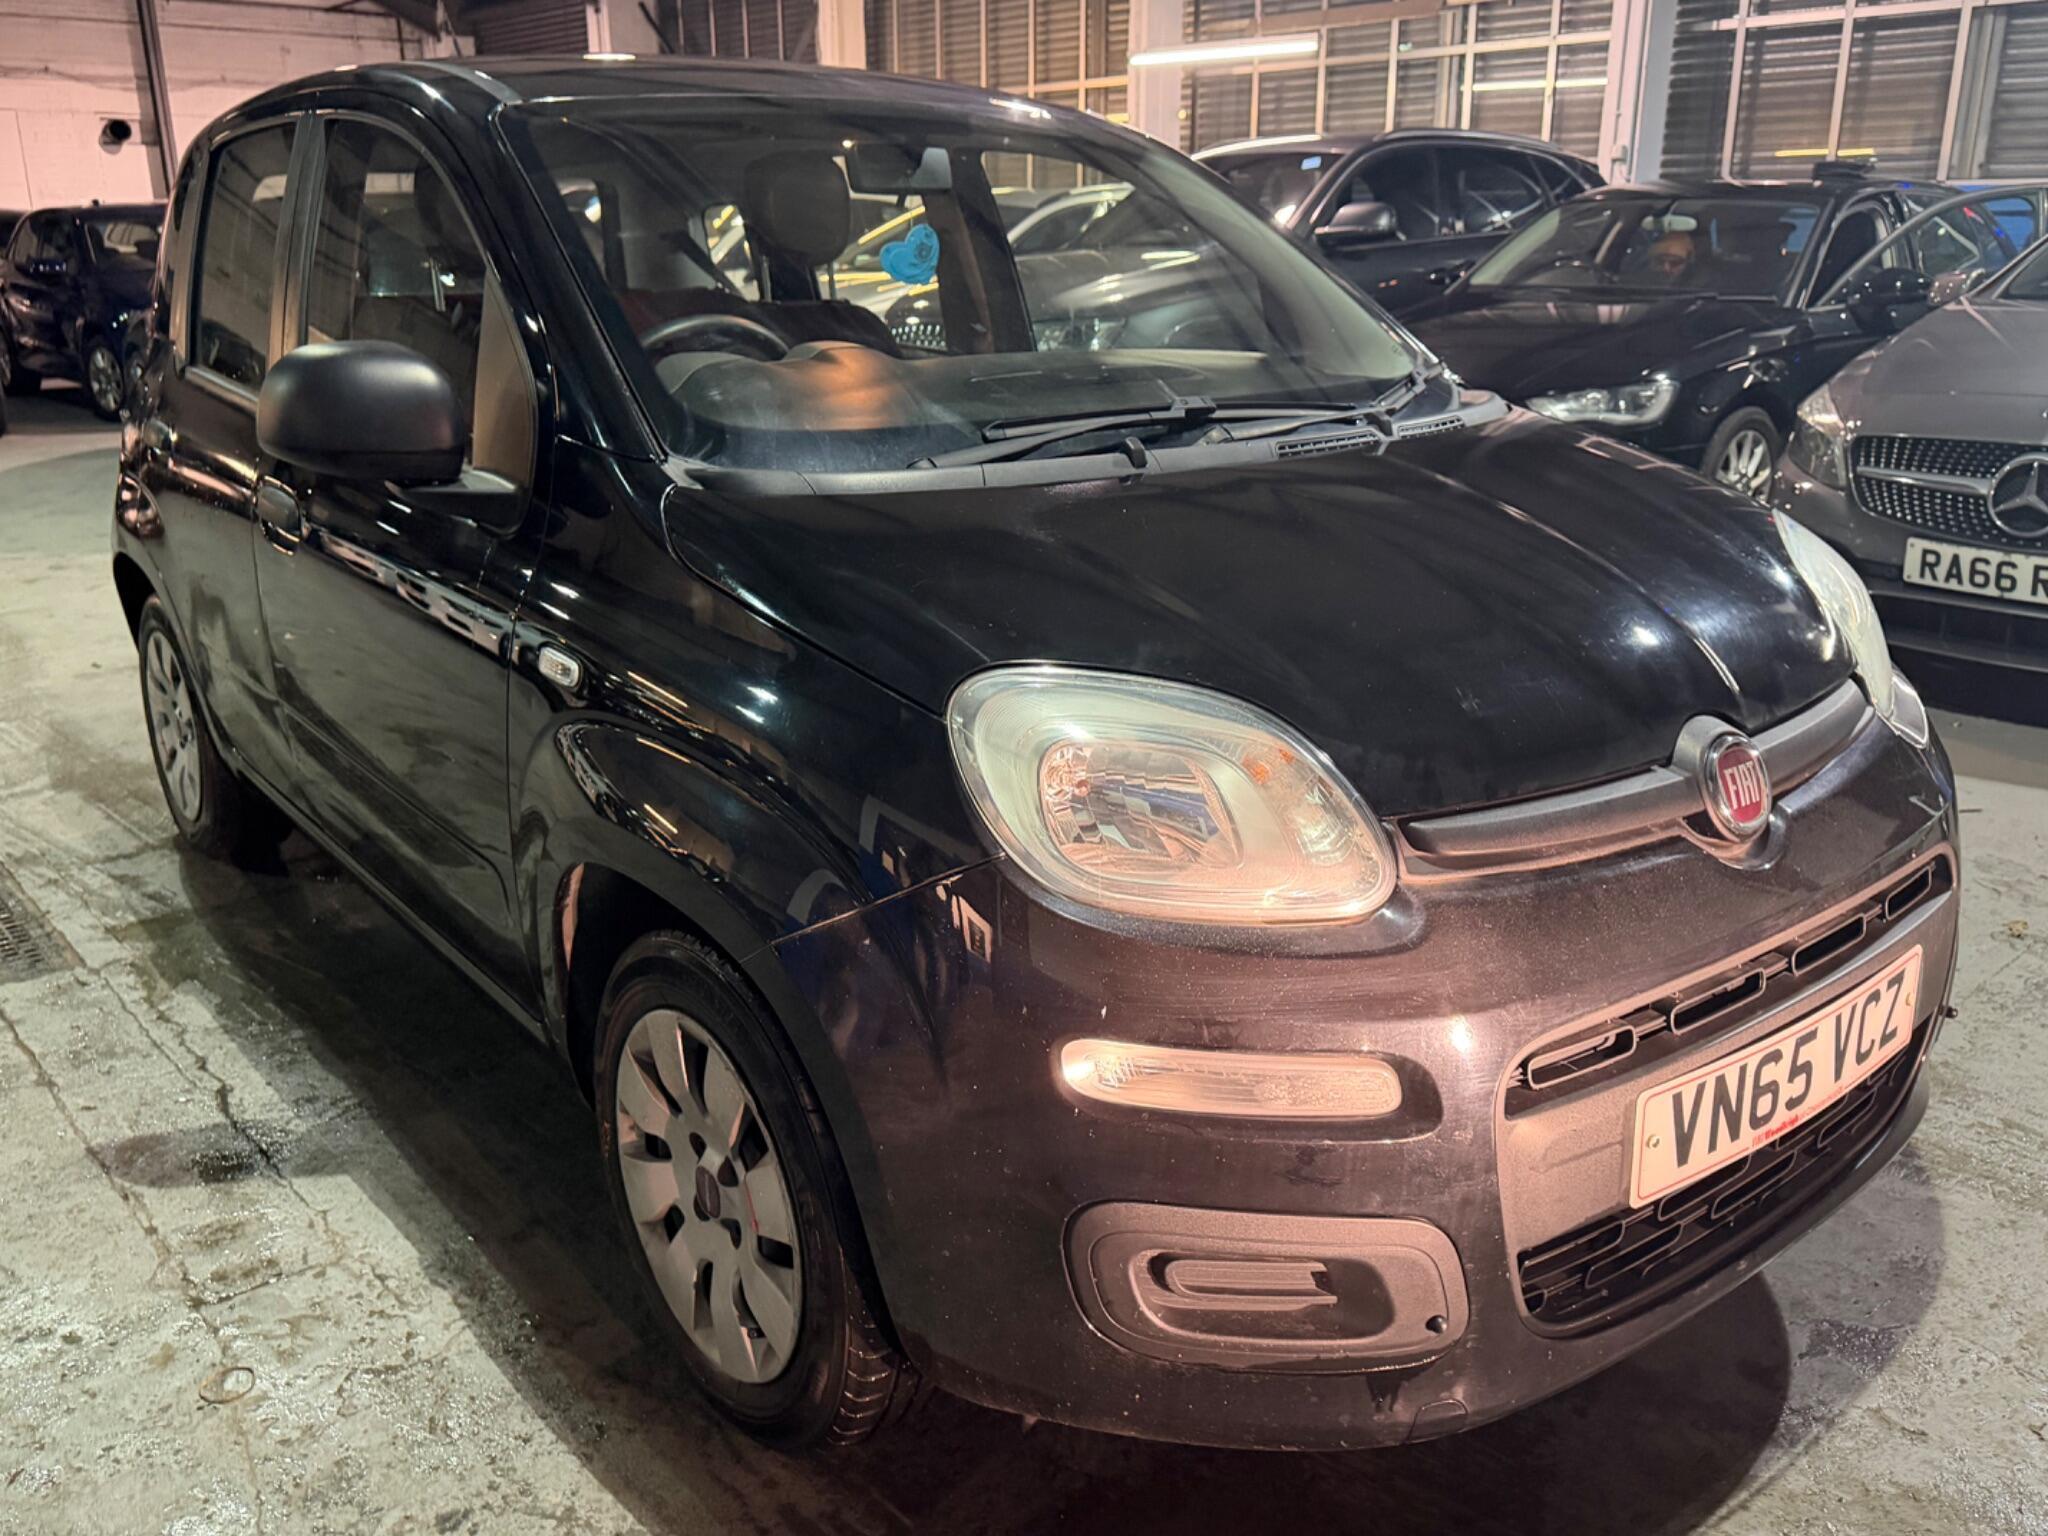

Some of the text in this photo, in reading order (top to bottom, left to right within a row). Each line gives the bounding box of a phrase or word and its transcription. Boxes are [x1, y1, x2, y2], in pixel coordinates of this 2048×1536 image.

[1919, 548, 2048, 597] RA66 R
[1723, 760, 1761, 810] FIAT
[1672, 1027, 1819, 1168] VN65
[1833, 967, 1906, 1083] VCZ
